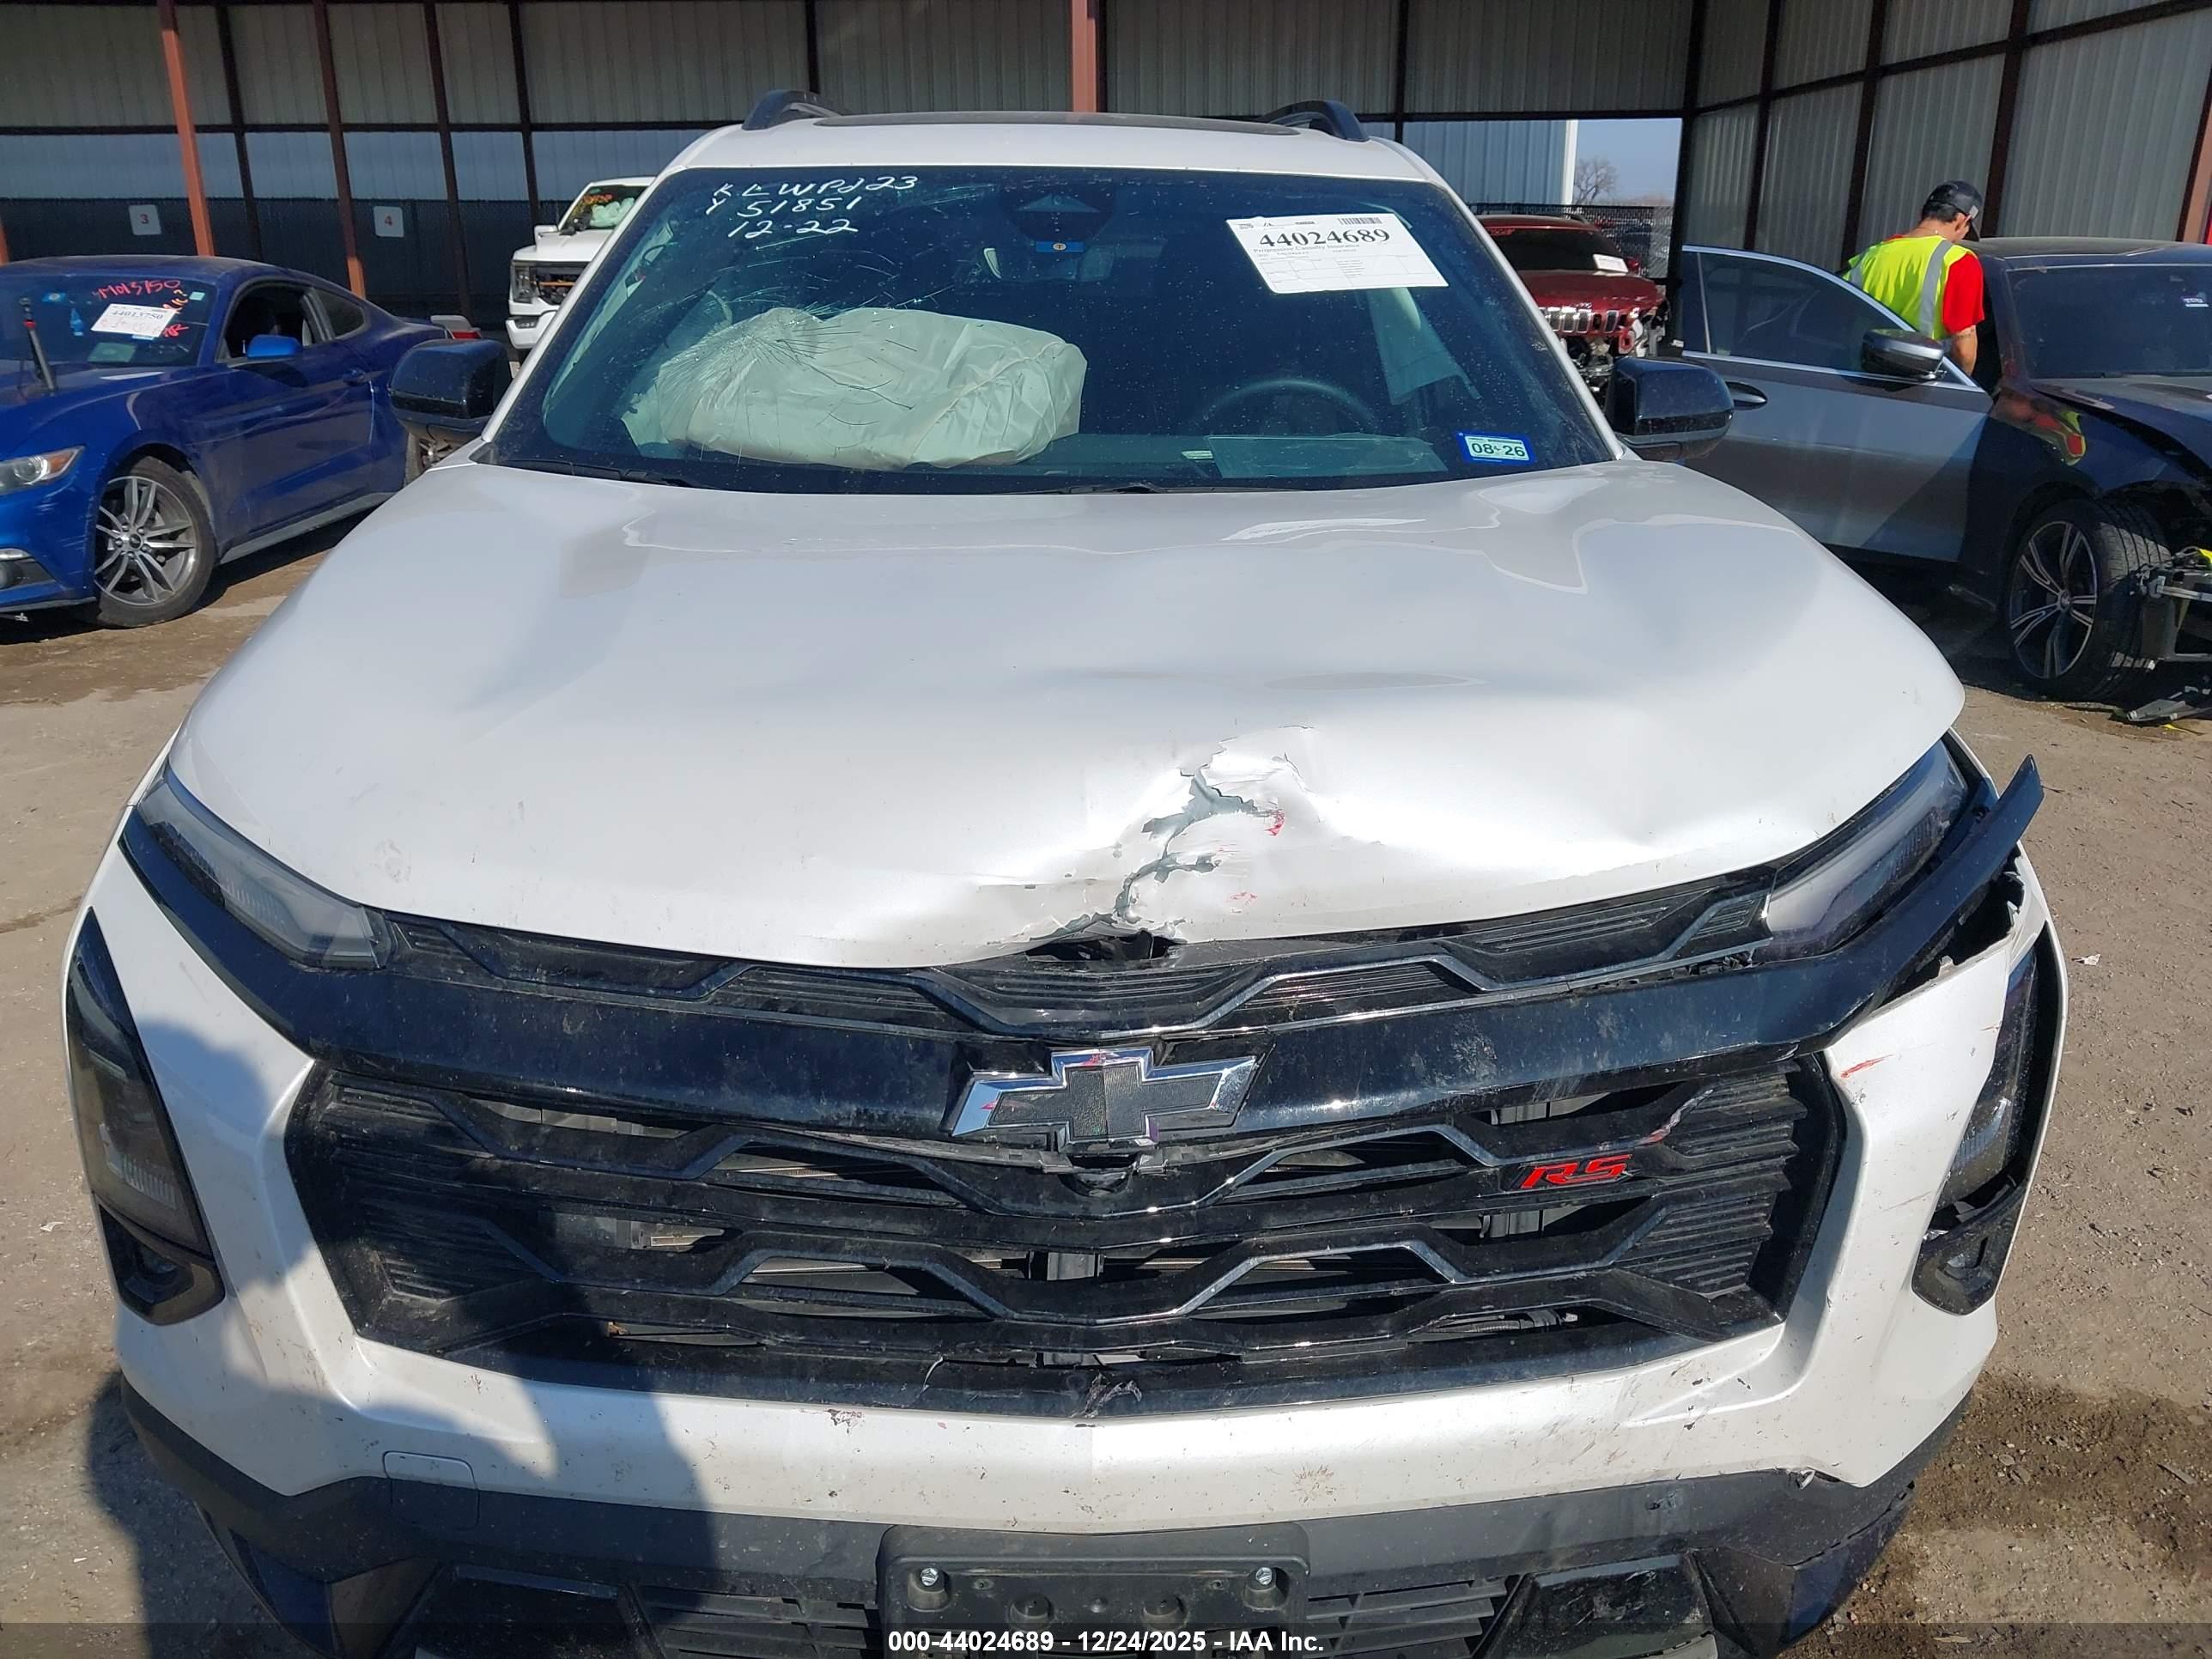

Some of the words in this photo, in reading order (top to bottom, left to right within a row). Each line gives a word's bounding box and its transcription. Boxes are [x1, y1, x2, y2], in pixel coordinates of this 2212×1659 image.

[139, 213, 149, 225] 3
[384, 215, 392, 228] 4
[727, 218, 860, 239] 12-22
[1259, 228, 1390, 247] 44024689
[1520, 1153, 1633, 1189] RS
